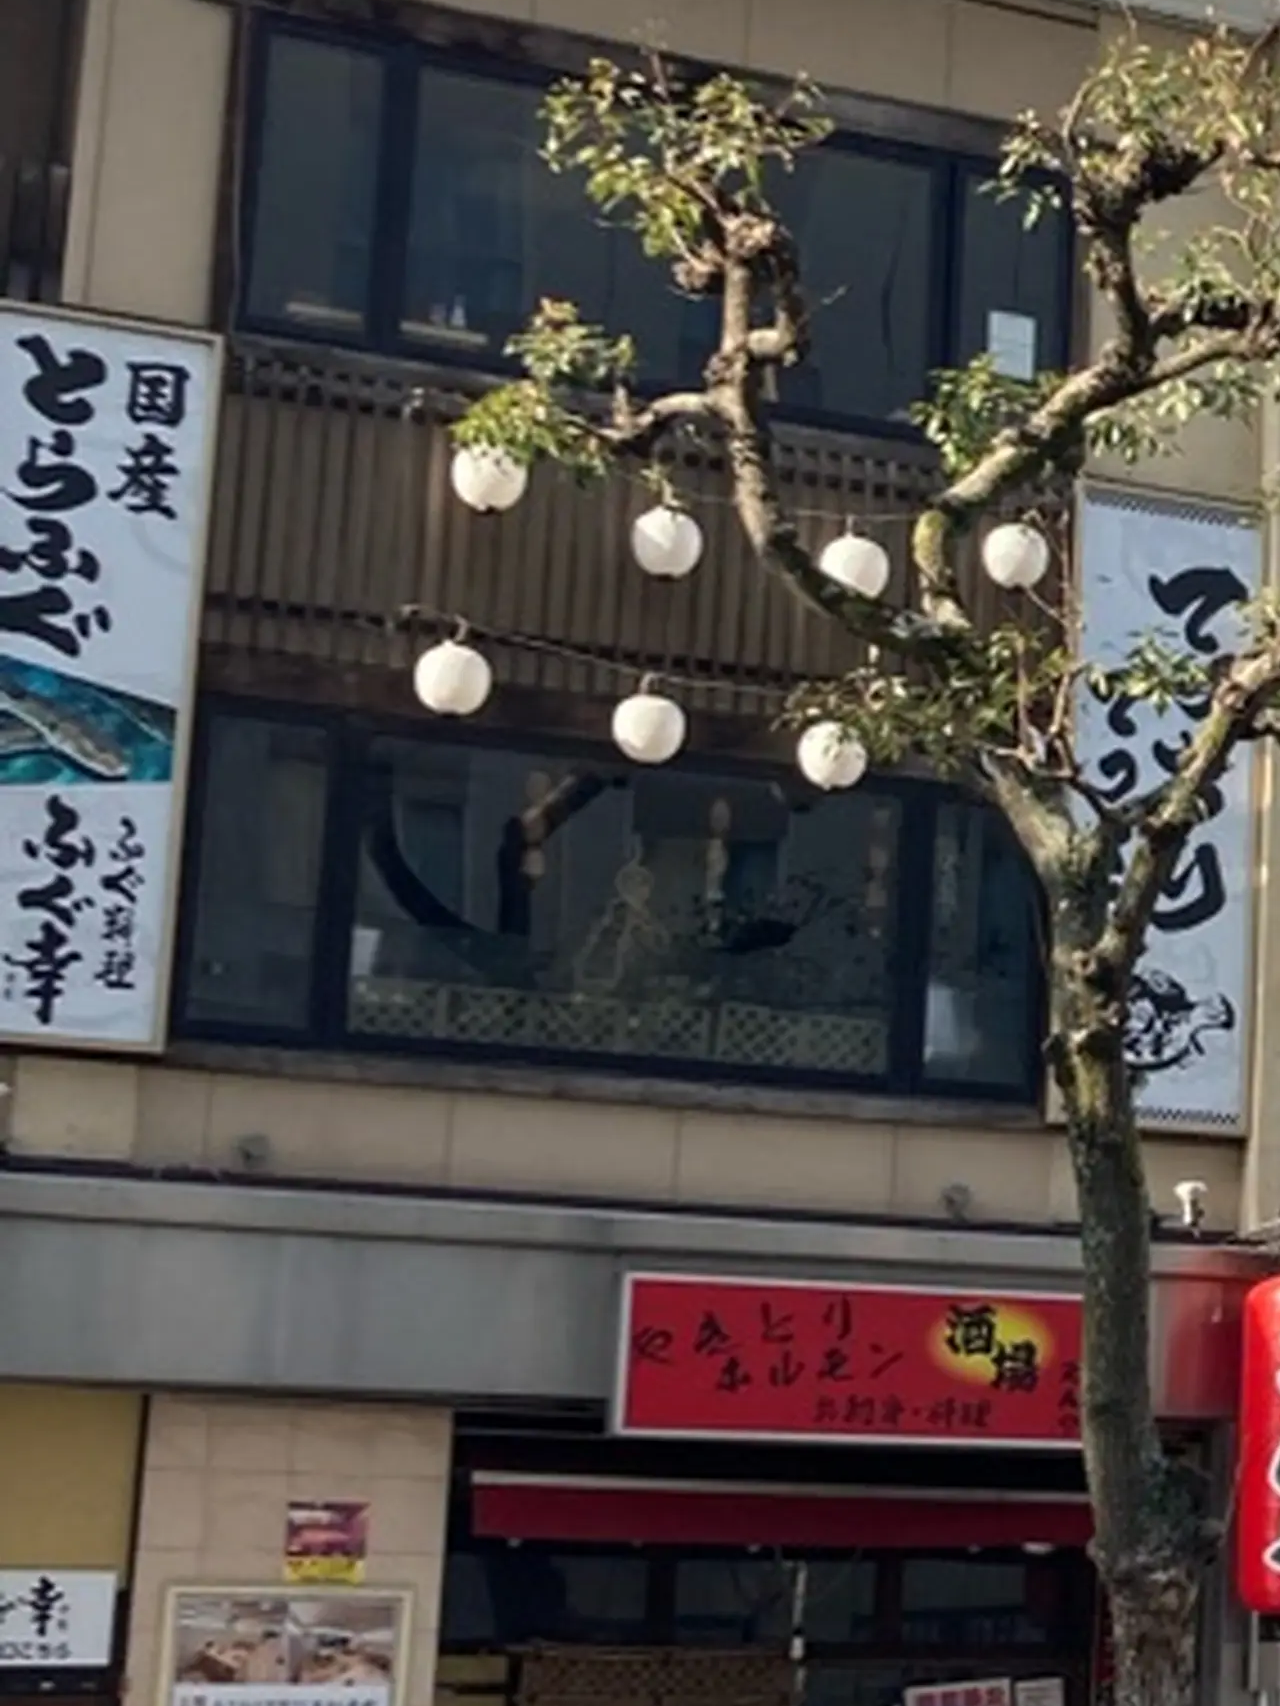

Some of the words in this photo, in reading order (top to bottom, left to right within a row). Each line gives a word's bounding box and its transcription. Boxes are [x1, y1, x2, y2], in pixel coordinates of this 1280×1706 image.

[0, 333, 113, 658] とらふぐ
[106, 359, 191, 520] 国産
[16, 794, 97, 1026] ふぐ幸
[633, 1294, 855, 1366] やきとり
[716, 1340, 904, 1394] ホルモン
[944, 1301, 1040, 1394] 酒場
